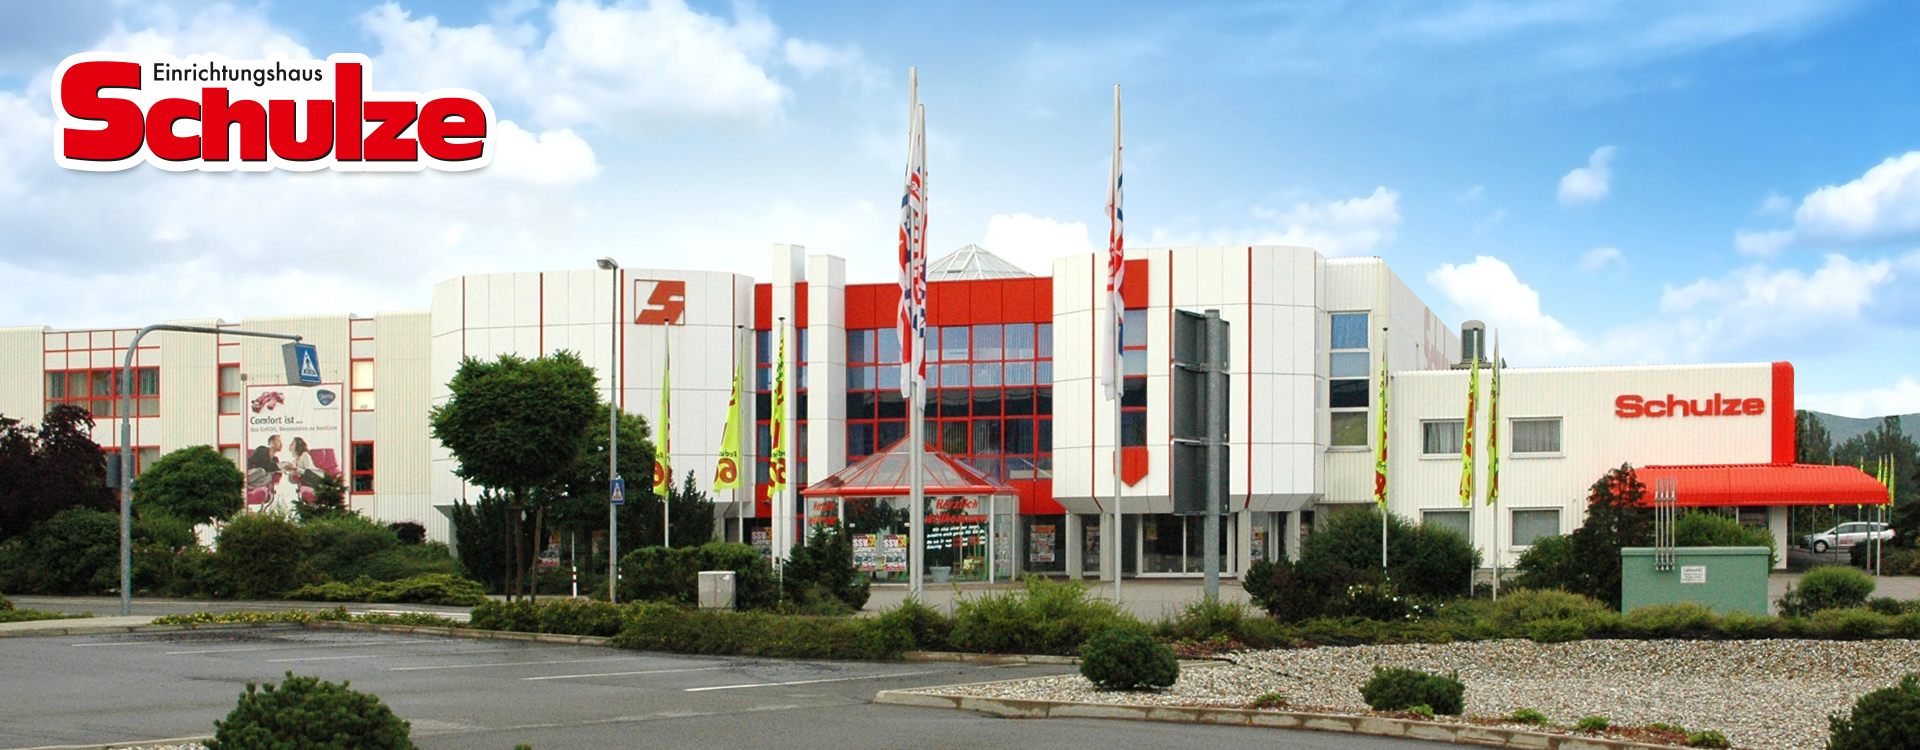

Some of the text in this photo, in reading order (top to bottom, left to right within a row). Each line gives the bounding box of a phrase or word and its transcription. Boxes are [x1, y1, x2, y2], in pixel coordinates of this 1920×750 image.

[1615, 393, 1765, 418] Schulze
[250, 416, 282, 425] Comfort
[284, 415, 294, 424] ist
[936, 498, 979, 509] Herzlich
[852, 539, 869, 547] SSV
[882, 540, 899, 548] SSV
